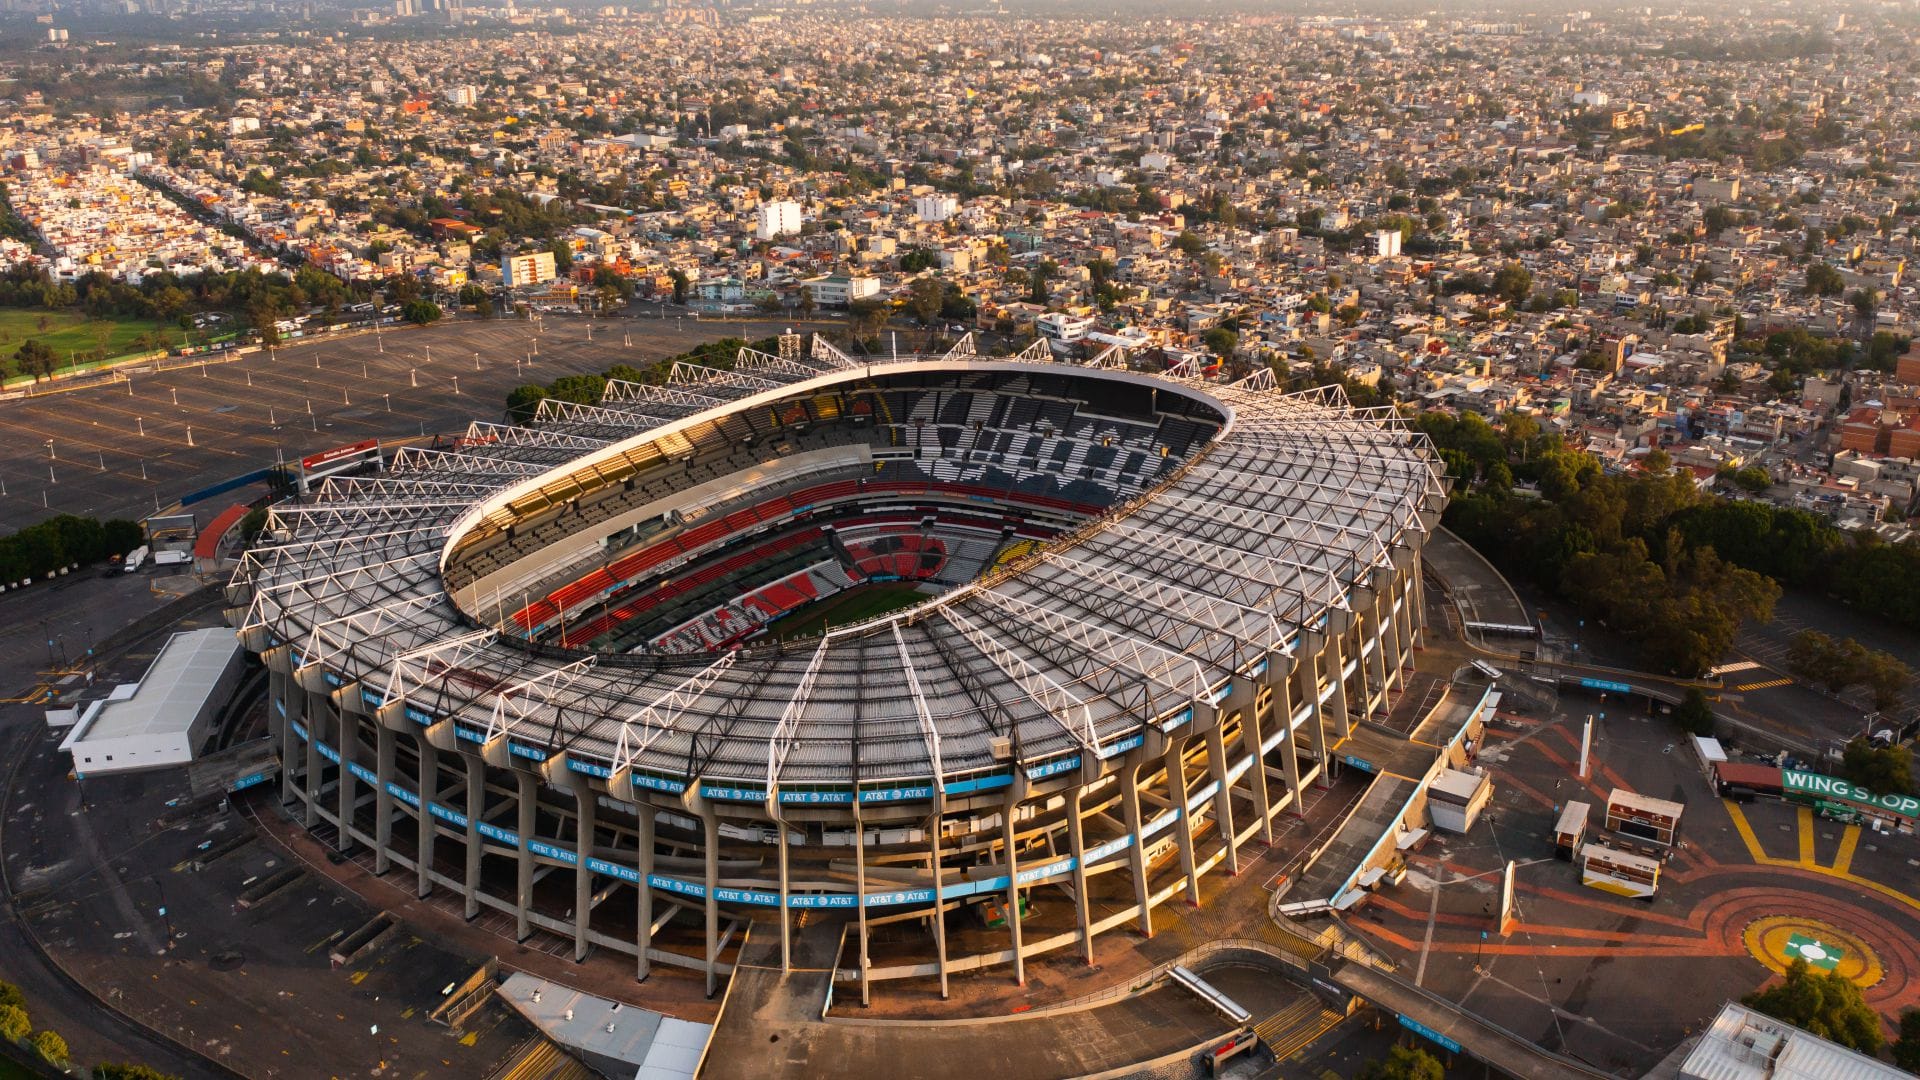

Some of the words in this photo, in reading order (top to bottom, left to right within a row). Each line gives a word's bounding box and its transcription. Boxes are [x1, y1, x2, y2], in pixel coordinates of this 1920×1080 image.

[458, 729, 474, 741] AT&T
[513, 746, 530, 757] AT&T
[1119, 738, 1139, 752] AT&T
[572, 762, 590, 774] AT&T
[1056, 760, 1077, 772] AT&T
[636, 777, 656, 787] AT&T
[669, 783, 684, 793] AT&
[1785, 772, 1849, 795] WING
[707, 788, 729, 798] AT&T
[744, 791, 767, 800] AT&T
[783, 793, 807, 802] AT&T
[822, 793, 846, 802] AT&T
[863, 791, 889, 801] AT&T
[903, 788, 928, 798] AT&T
[532, 843, 549, 854] AT&T
[559, 852, 577, 863] AT&T
[590, 861, 608, 872] AT&T
[620, 869, 639, 880] AT&T
[1018, 871, 1039, 882] AT&T
[1053, 861, 1072, 873] AT&T
[652, 877, 671, 888] AT&T
[684, 884, 704, 895] AT&T
[718, 891, 740, 900] AT&T
[753, 894, 776, 904] AT&T
[791, 897, 815, 906] AT&T
[830, 897, 853, 905] AT&T
[869, 895, 893, 904] AT&T
[907, 891, 930, 901] AT&T
